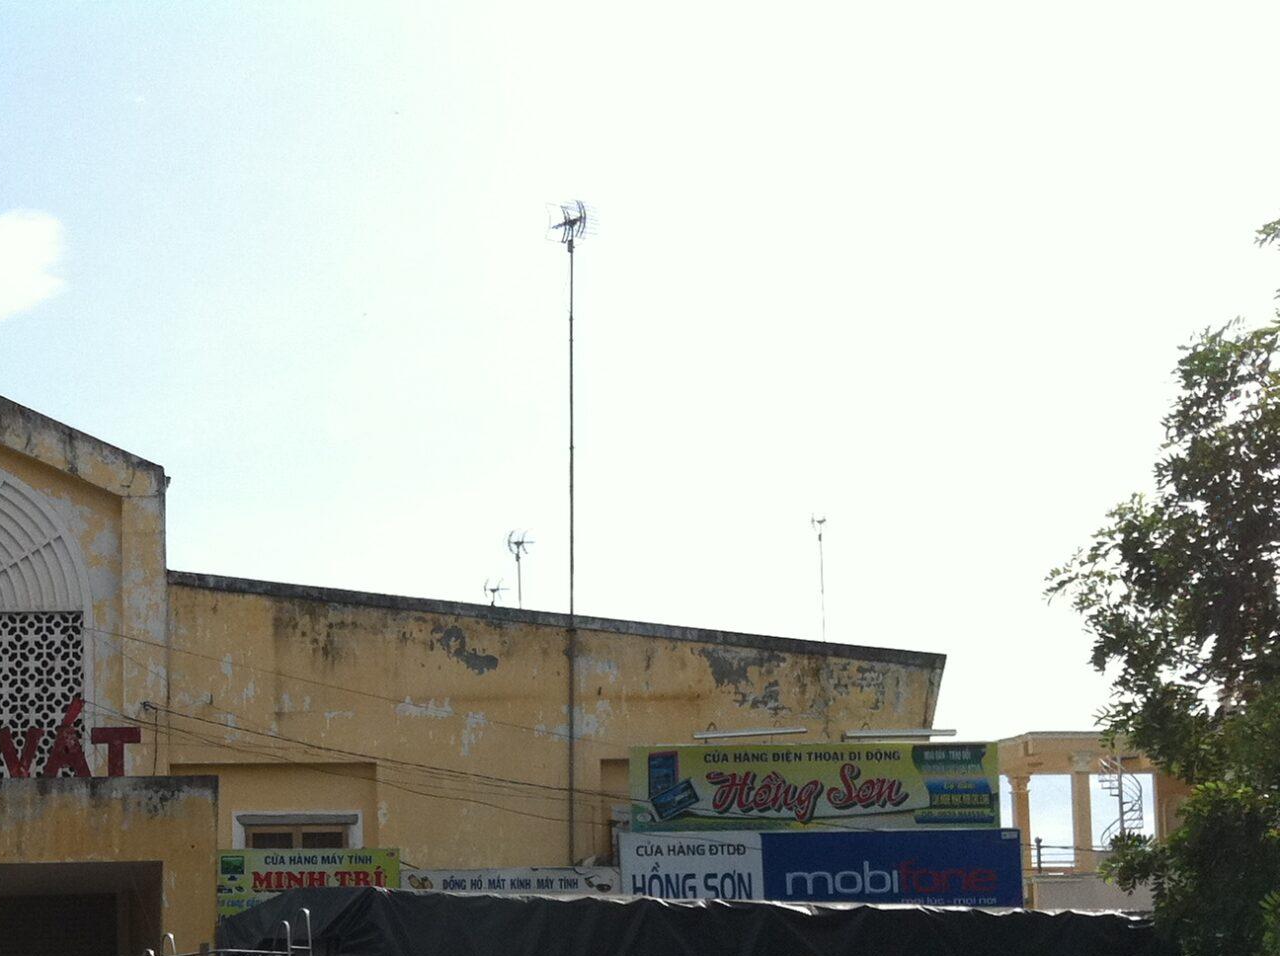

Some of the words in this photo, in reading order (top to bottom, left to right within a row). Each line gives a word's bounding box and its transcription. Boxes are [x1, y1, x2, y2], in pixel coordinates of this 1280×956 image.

[733, 750, 768, 763] HÀNG
[806, 750, 844, 764] THOẠI
[866, 749, 901, 763] ĐỘNG
[636, 841, 664, 857] CỬA
[667, 841, 706, 857] HÀNG
[708, 843, 746, 856] ĐTDĐ
[289, 852, 318, 865] HÀNG
[321, 853, 344, 865] MÁY
[348, 853, 372, 865] TÍNH
[251, 870, 328, 890] MINH
[334, 865, 387, 888] TRÍ
[537, 875, 555, 890] MÁY
[558, 875, 579, 890] TÍNH
[632, 861, 697, 899] HỒNG
[703, 869, 753, 900] SƠN
[786, 858, 997, 895] mobifone
